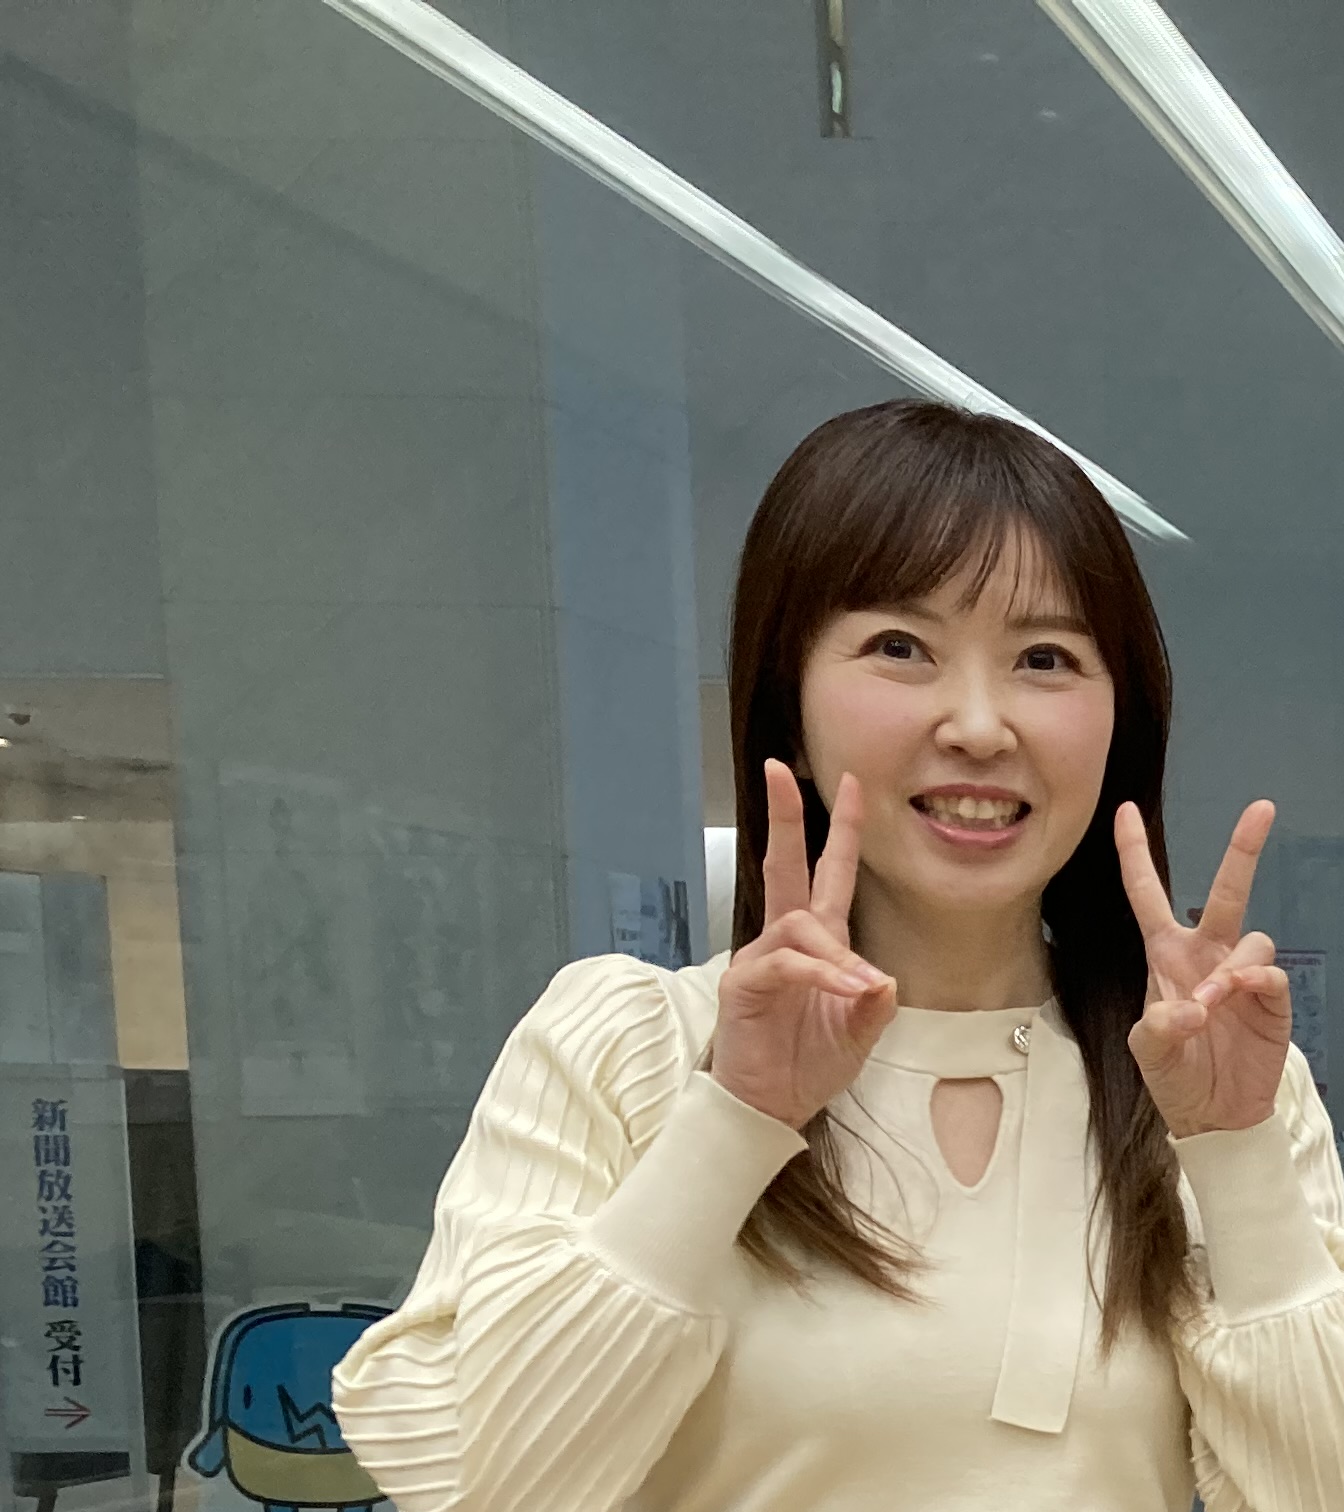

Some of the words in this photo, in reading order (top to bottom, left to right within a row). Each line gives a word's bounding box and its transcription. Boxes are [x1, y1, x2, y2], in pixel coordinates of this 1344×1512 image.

[32, 1098, 79, 1309] 新聞放送会館
[45, 1319, 84, 1388] 受付
